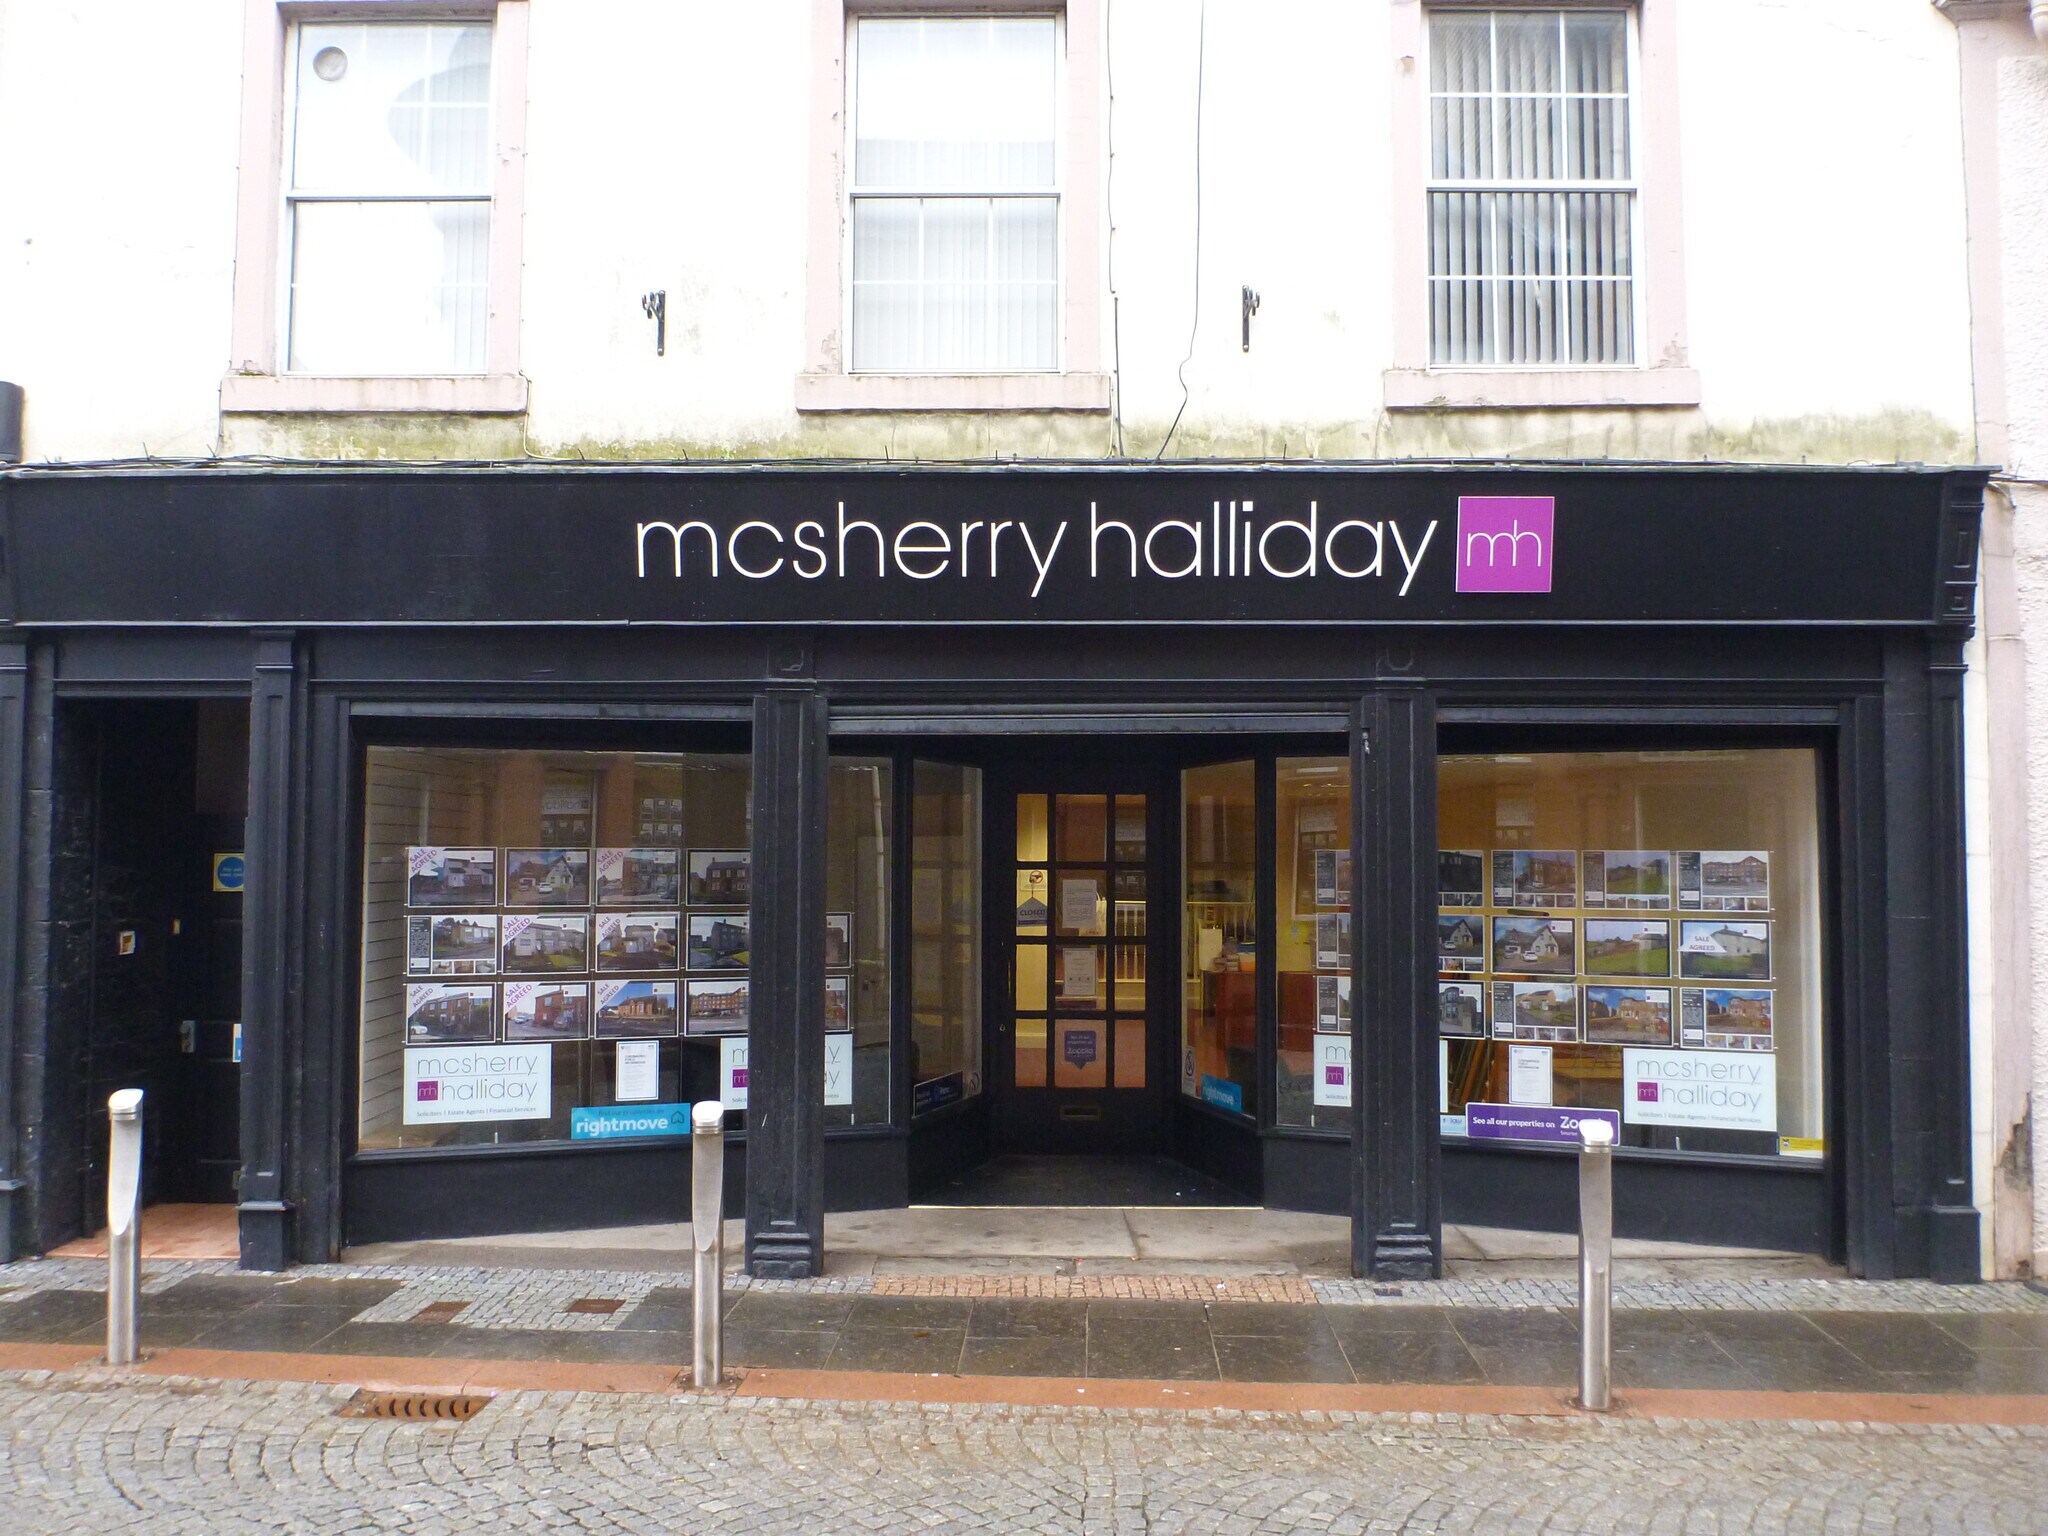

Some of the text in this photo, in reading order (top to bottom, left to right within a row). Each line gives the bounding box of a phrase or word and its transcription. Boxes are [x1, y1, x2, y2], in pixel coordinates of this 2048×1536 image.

[636, 500, 1438, 598] mcsherry halliday
[1466, 519, 1542, 567] mh
[410, 849, 428, 863] SALE
[411, 849, 438, 873] AGREED
[597, 850, 614, 864] SALE
[599, 850, 624, 874] AGREED
[598, 916, 612, 929] SALE
[1020, 909, 1046, 917] CLOSED
[503, 916, 521, 932] SALE
[504, 917, 531, 941] AGREED
[601, 918, 621, 938] AGREED
[1694, 935, 1710, 943] SALE
[410, 985, 424, 998] SALE
[412, 987, 434, 1008] AGREED
[505, 983, 522, 999] SALE
[506, 984, 533, 1008] AGREED
[597, 983, 610, 995] SALE
[600, 985, 620, 1005] AGREED
[417, 1053, 538, 1076] mcsherry
[1637, 1057, 1761, 1085] mcsherry
[441, 1078, 538, 1102] halliday
[1662, 1083, 1762, 1112] halliday
[576, 1117, 669, 1136] rightmove
[1472, 1116, 1486, 1124] See
[1487, 1117, 1495, 1125] all
[1508, 1118, 1545, 1128] properties
